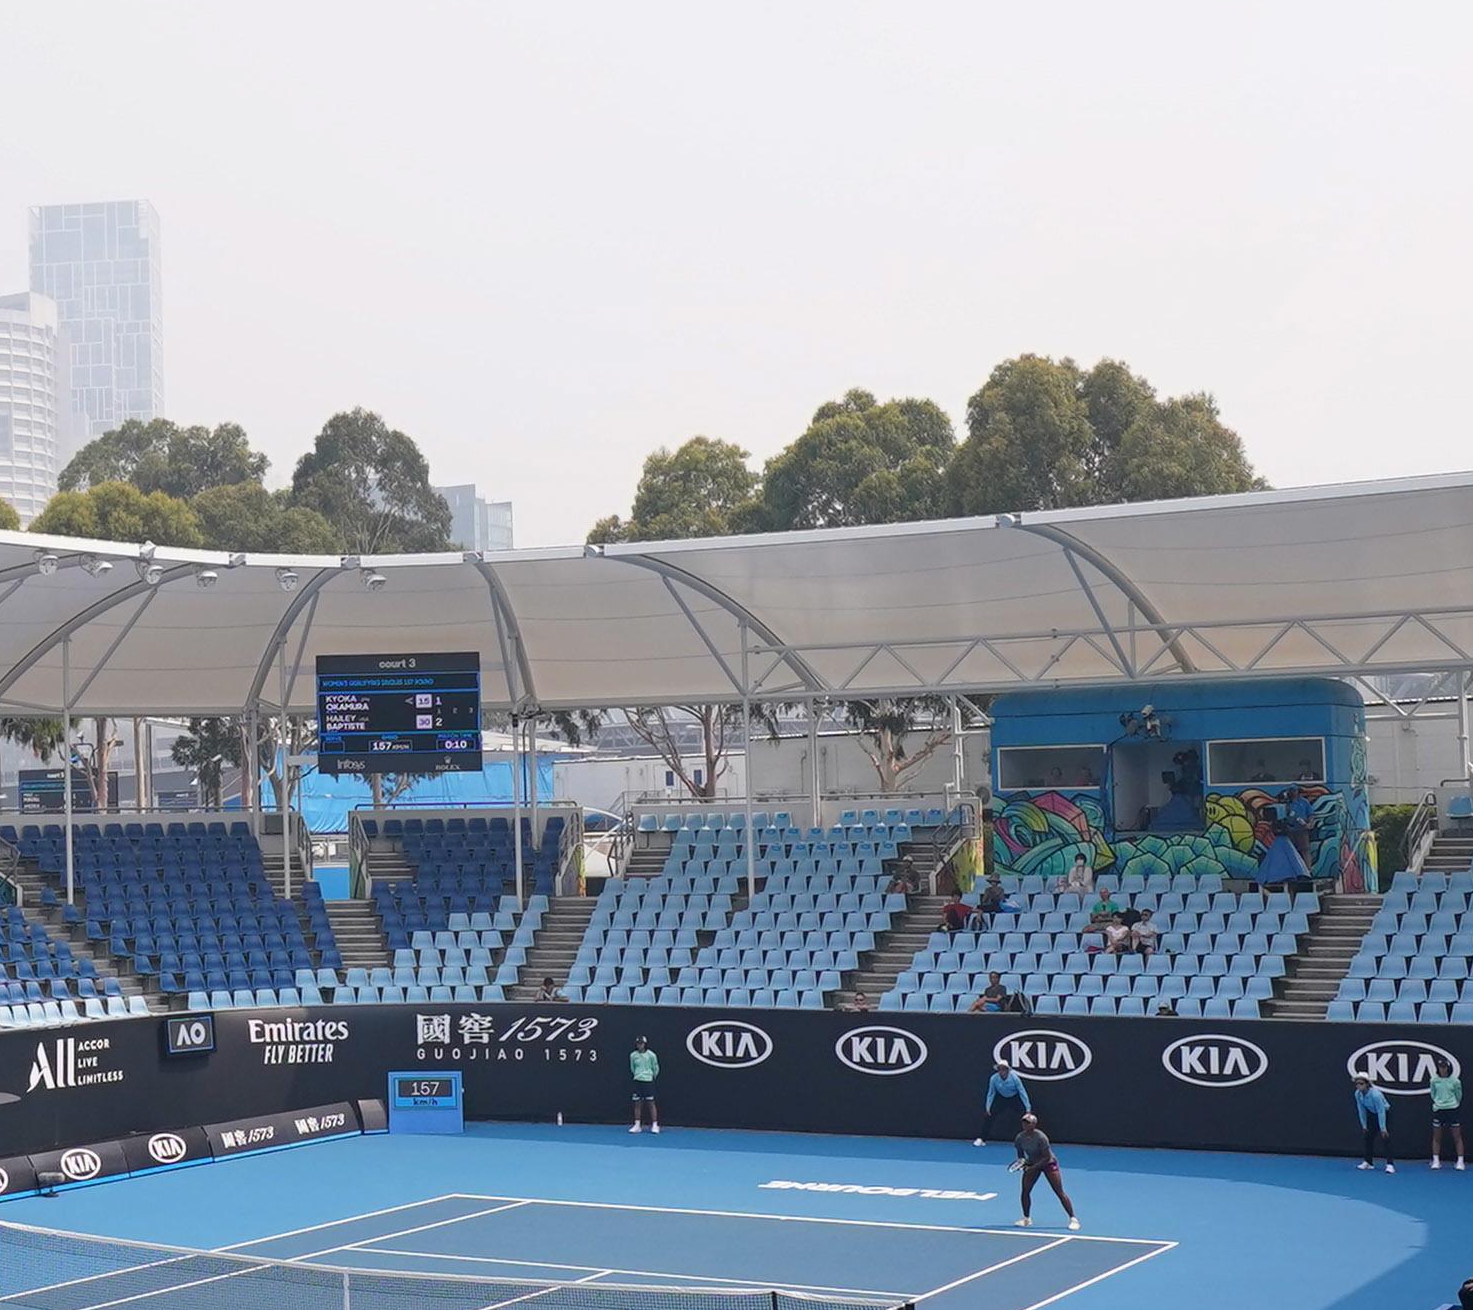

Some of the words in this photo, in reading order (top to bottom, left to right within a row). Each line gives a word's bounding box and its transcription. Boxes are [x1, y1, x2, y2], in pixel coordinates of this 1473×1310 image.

[408, 658, 416, 668] 3
[326, 695, 357, 703] KYOKA
[326, 703, 369, 711] OKAMURA
[435, 718, 443, 726] 2
[372, 742, 391, 750] 157
[445, 741, 467, 749] 0:10
[176, 1021, 206, 1046] AO
[248, 1018, 349, 1043] Emirates
[498, 1016, 599, 1042] 1573
[78, 1039, 110, 1051] ACCOR
[701, 1030, 760, 1058] KIA
[851, 1036, 913, 1065] KIA
[264, 1044, 285, 1065] FLY
[288, 1043, 334, 1064] BETTER
[417, 1048, 525, 1060] GUOJIAO
[544, 1049, 598, 1061] 1573
[1009, 1040, 1076, 1070] KIA
[1180, 1045, 1251, 1076] KIA
[78, 1057, 98, 1068] LIVE
[1366, 1052, 1438, 1082] KIA
[78, 1070, 124, 1086] LIMITLESS
[411, 1081, 440, 1096] 157
[413, 1097, 438, 1106] km/h
[152, 1138, 181, 1158] KIA
[65, 1154, 95, 1174] KIA
